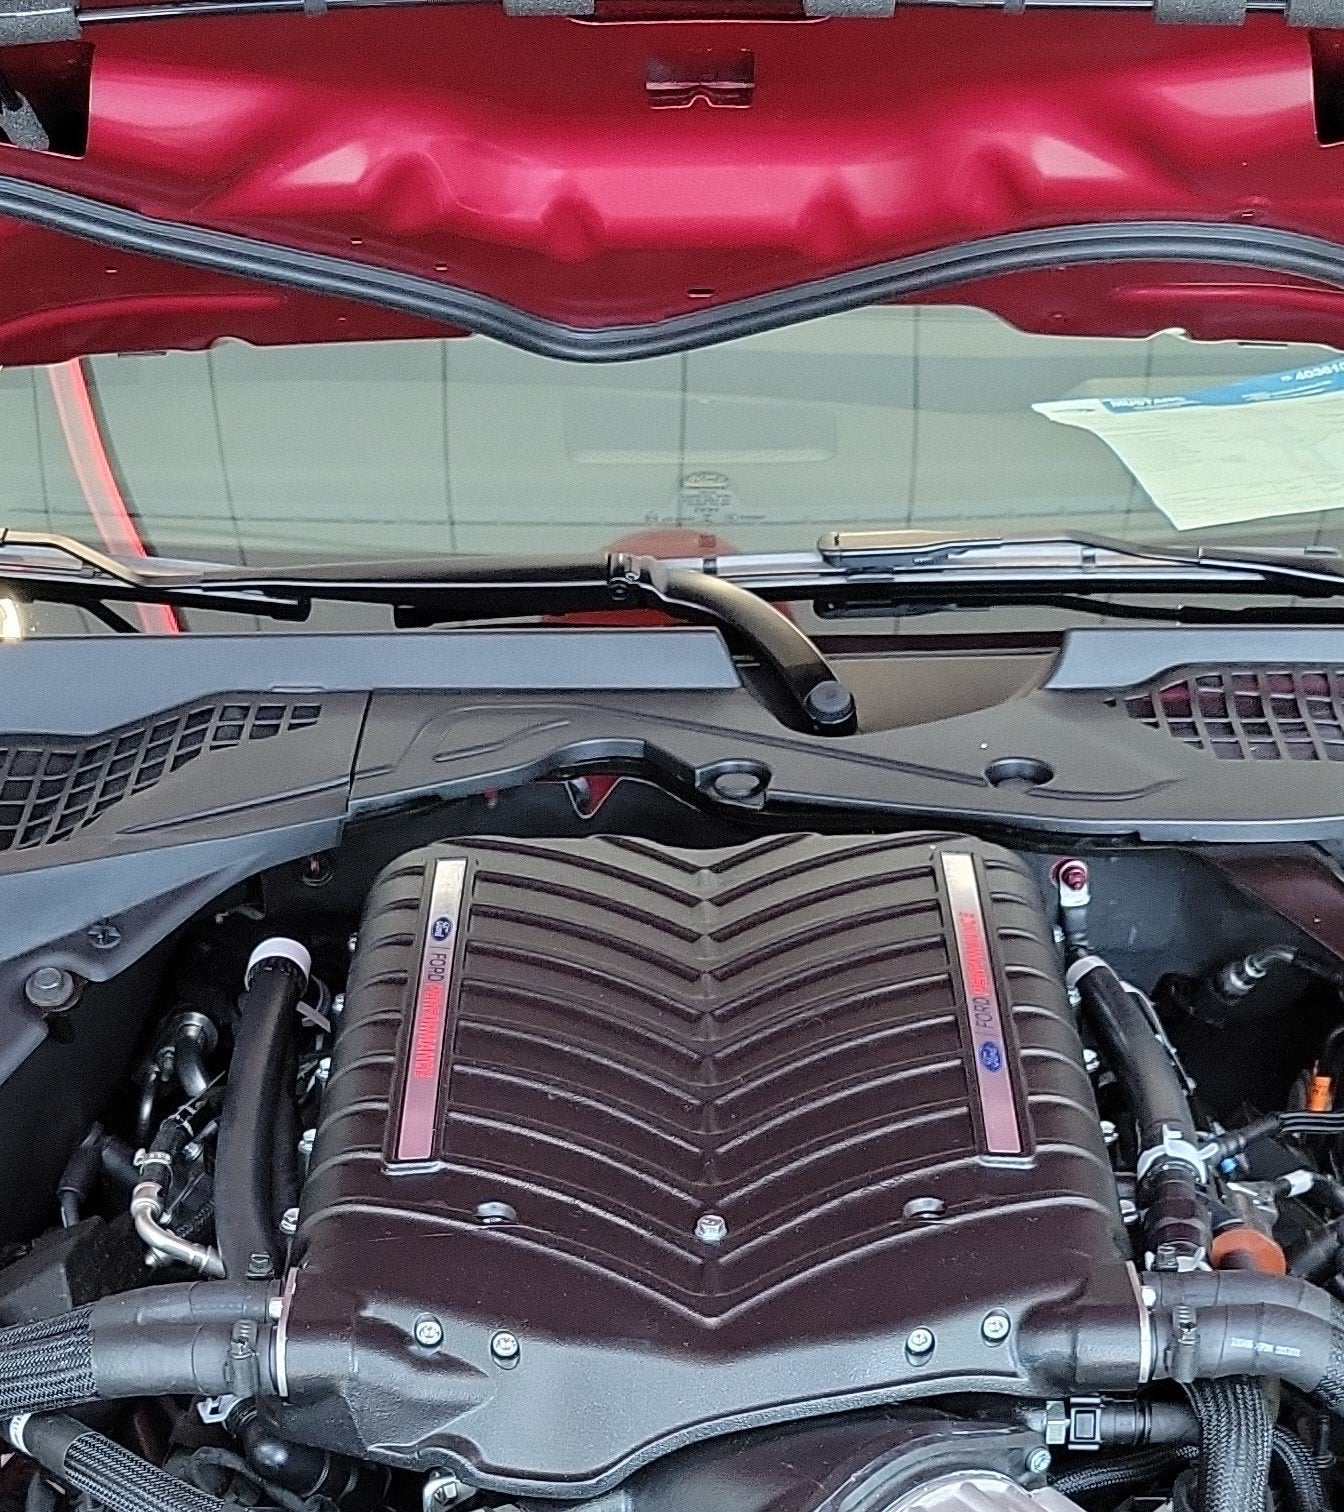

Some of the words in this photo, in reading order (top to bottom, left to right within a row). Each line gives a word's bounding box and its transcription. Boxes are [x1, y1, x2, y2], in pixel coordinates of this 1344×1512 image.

[428, 953, 447, 982] FORD
[972, 997, 993, 1029] FORD
[413, 983, 444, 1079] PERFORMANCE
